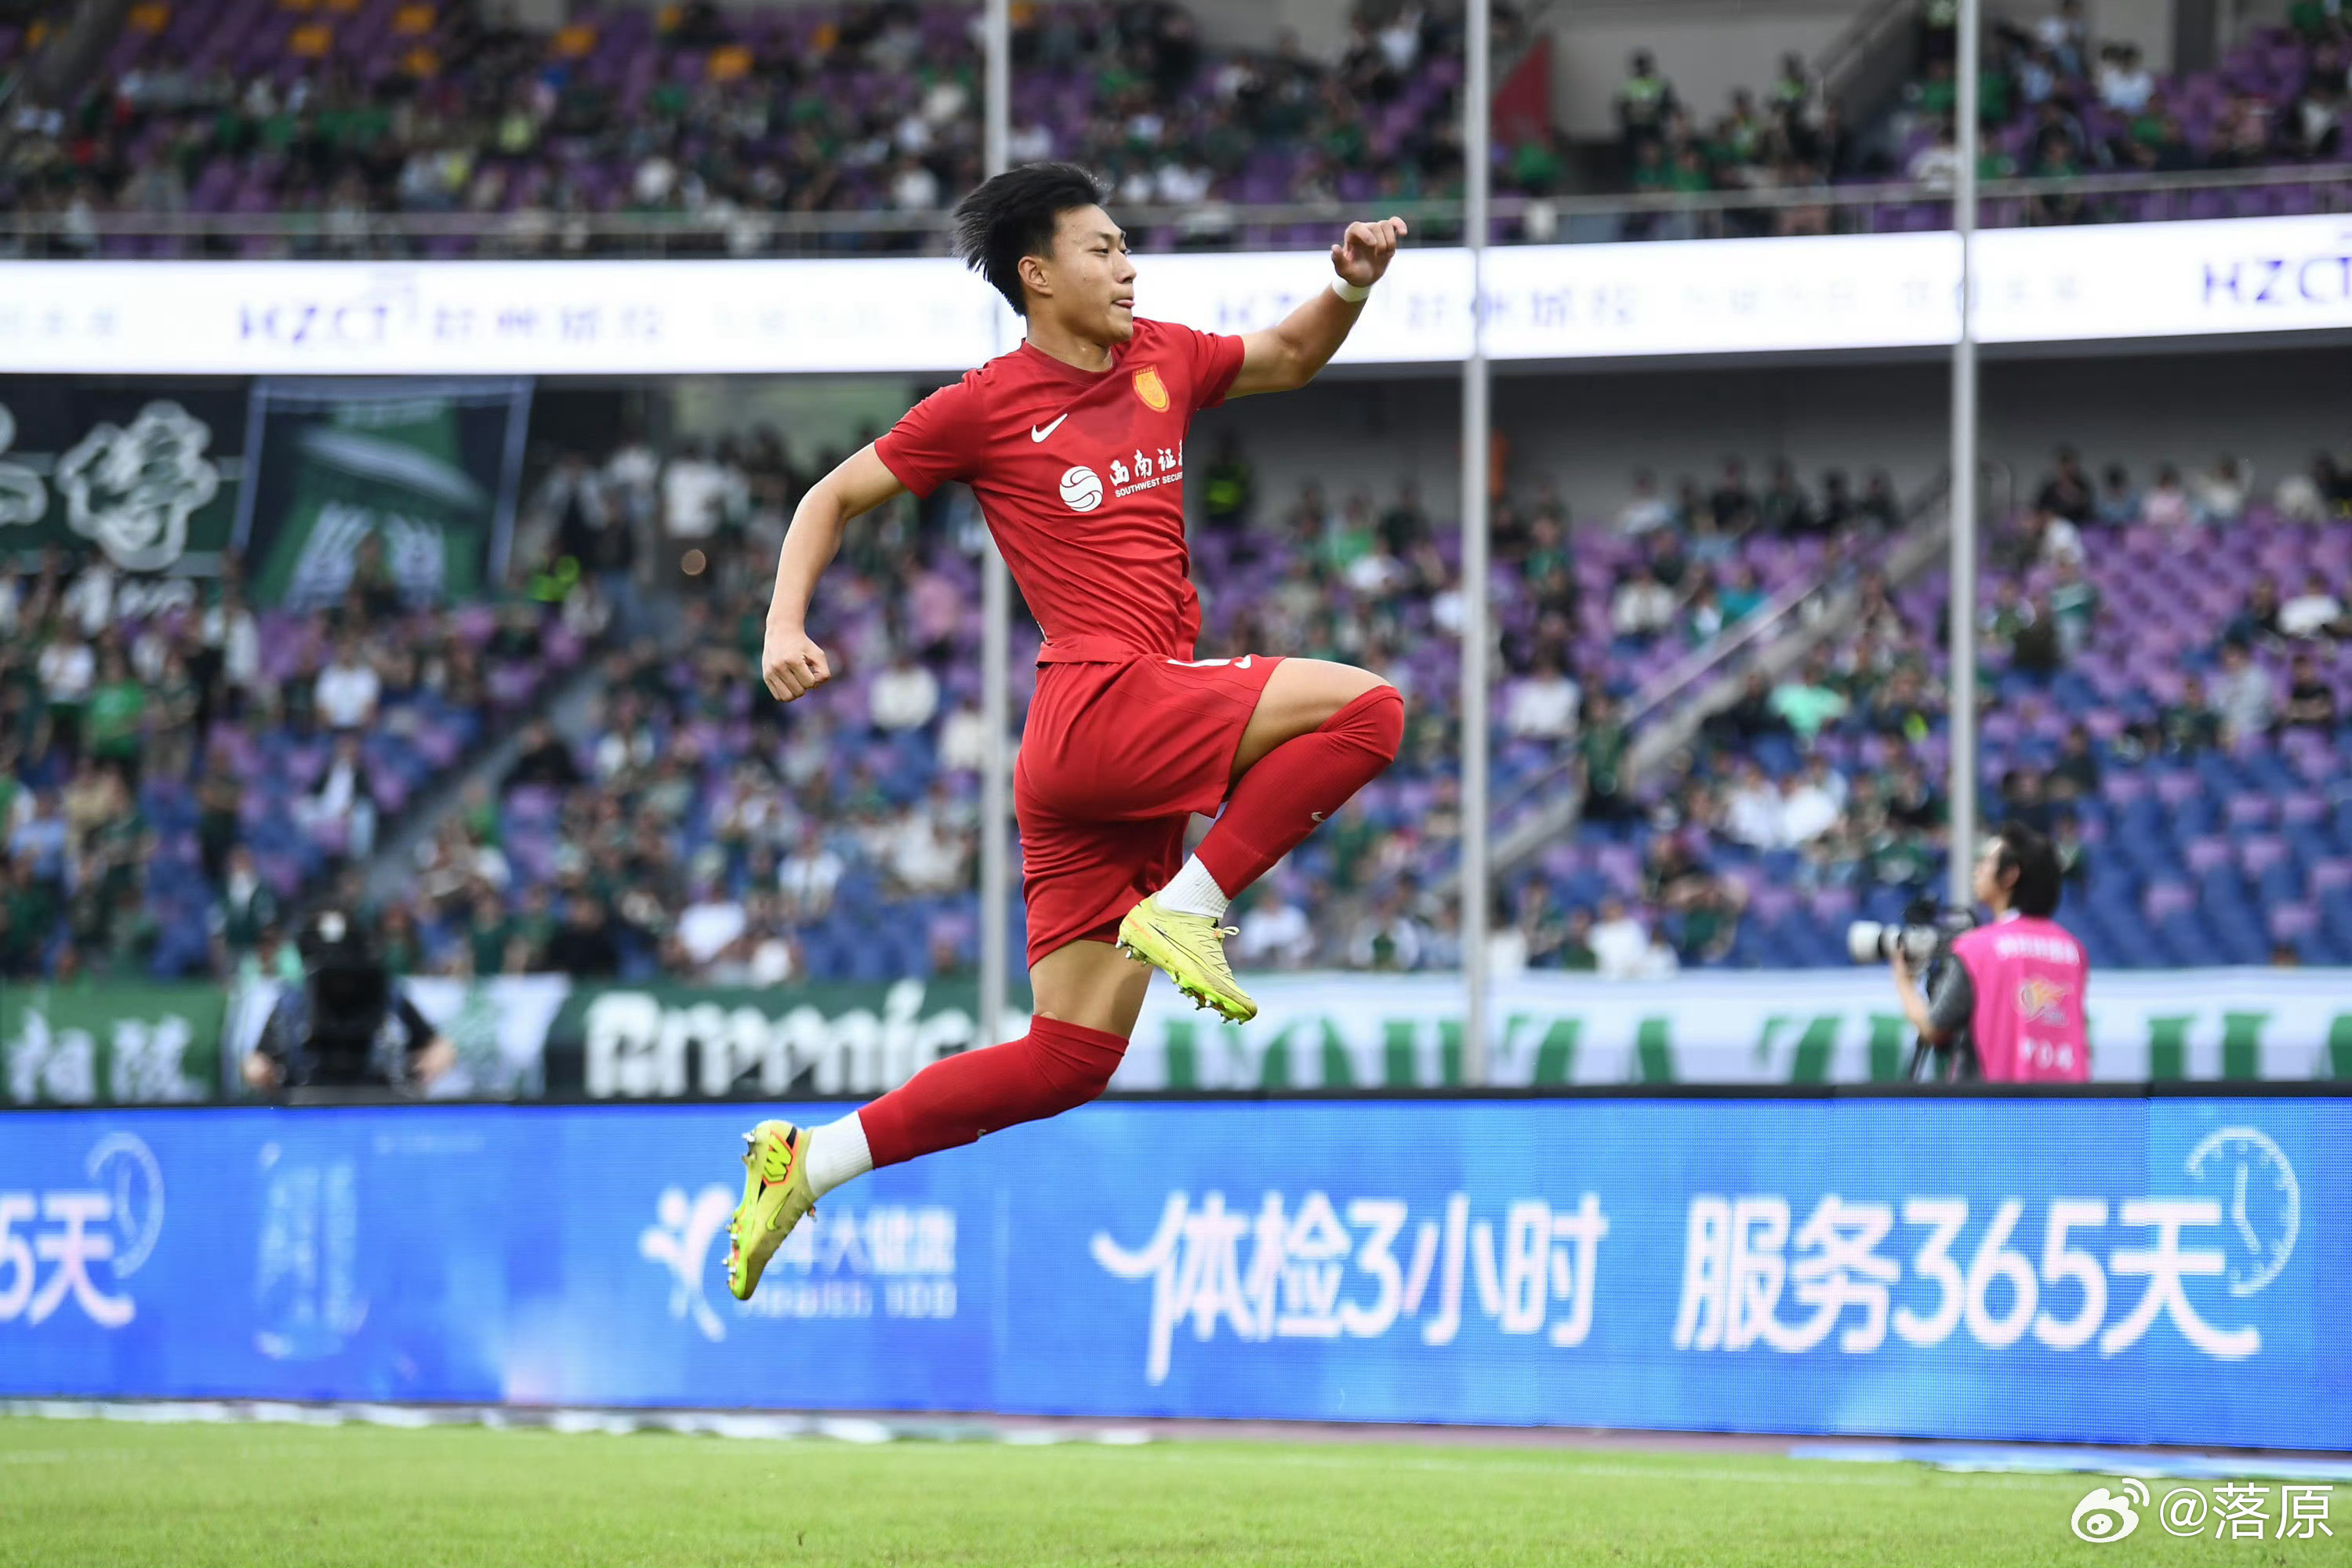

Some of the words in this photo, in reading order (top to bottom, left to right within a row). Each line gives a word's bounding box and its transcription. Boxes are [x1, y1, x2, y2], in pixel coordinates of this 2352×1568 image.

[1109, 439, 1182, 487] 西南证
[1115, 477, 1160, 498] SOUTHWEST
[1090, 1189, 1610, 1386] 体检3小时
[1673, 1194, 2262, 1358] 服务365天
